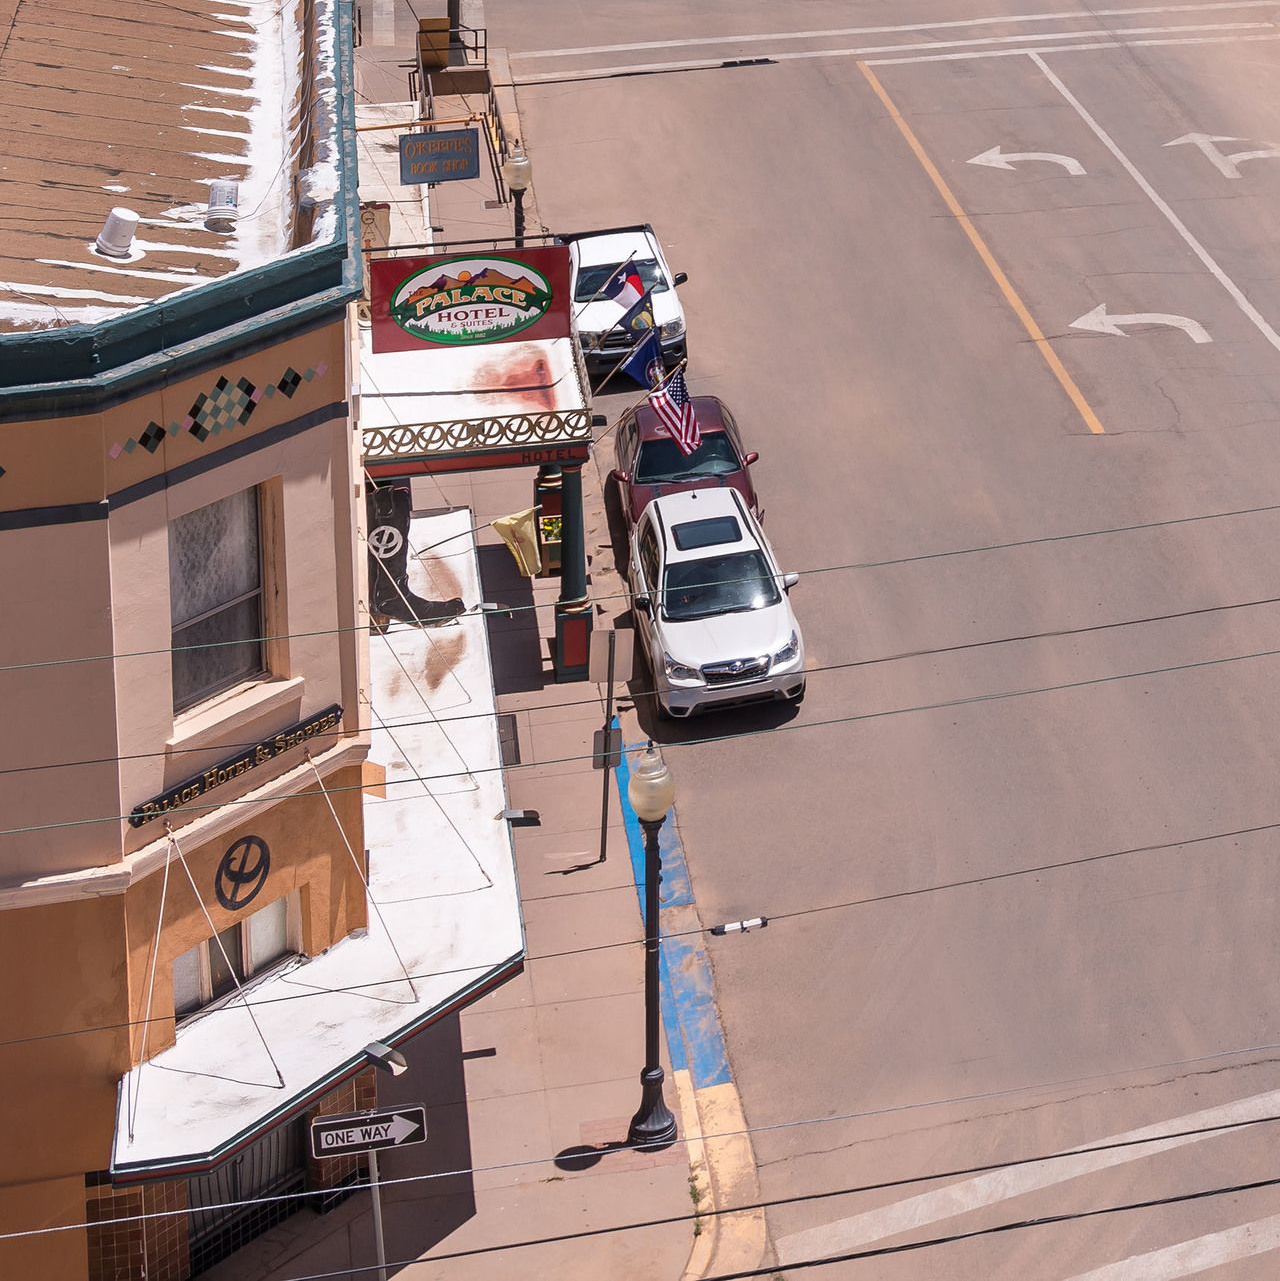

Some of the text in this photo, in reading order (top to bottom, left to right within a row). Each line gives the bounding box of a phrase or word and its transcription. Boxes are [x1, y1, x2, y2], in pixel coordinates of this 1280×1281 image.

[411, 160, 438, 176] BOOK
[415, 286, 526, 317] PALACE
[437, 307, 510, 323] HOTEL
[460, 319, 493, 328] SUITES
[521, 448, 577, 464] HOTEL
[142, 712, 336, 824] PALACE HOTEL & SHOPPES
[324, 1124, 391, 1146] ONE WAY
